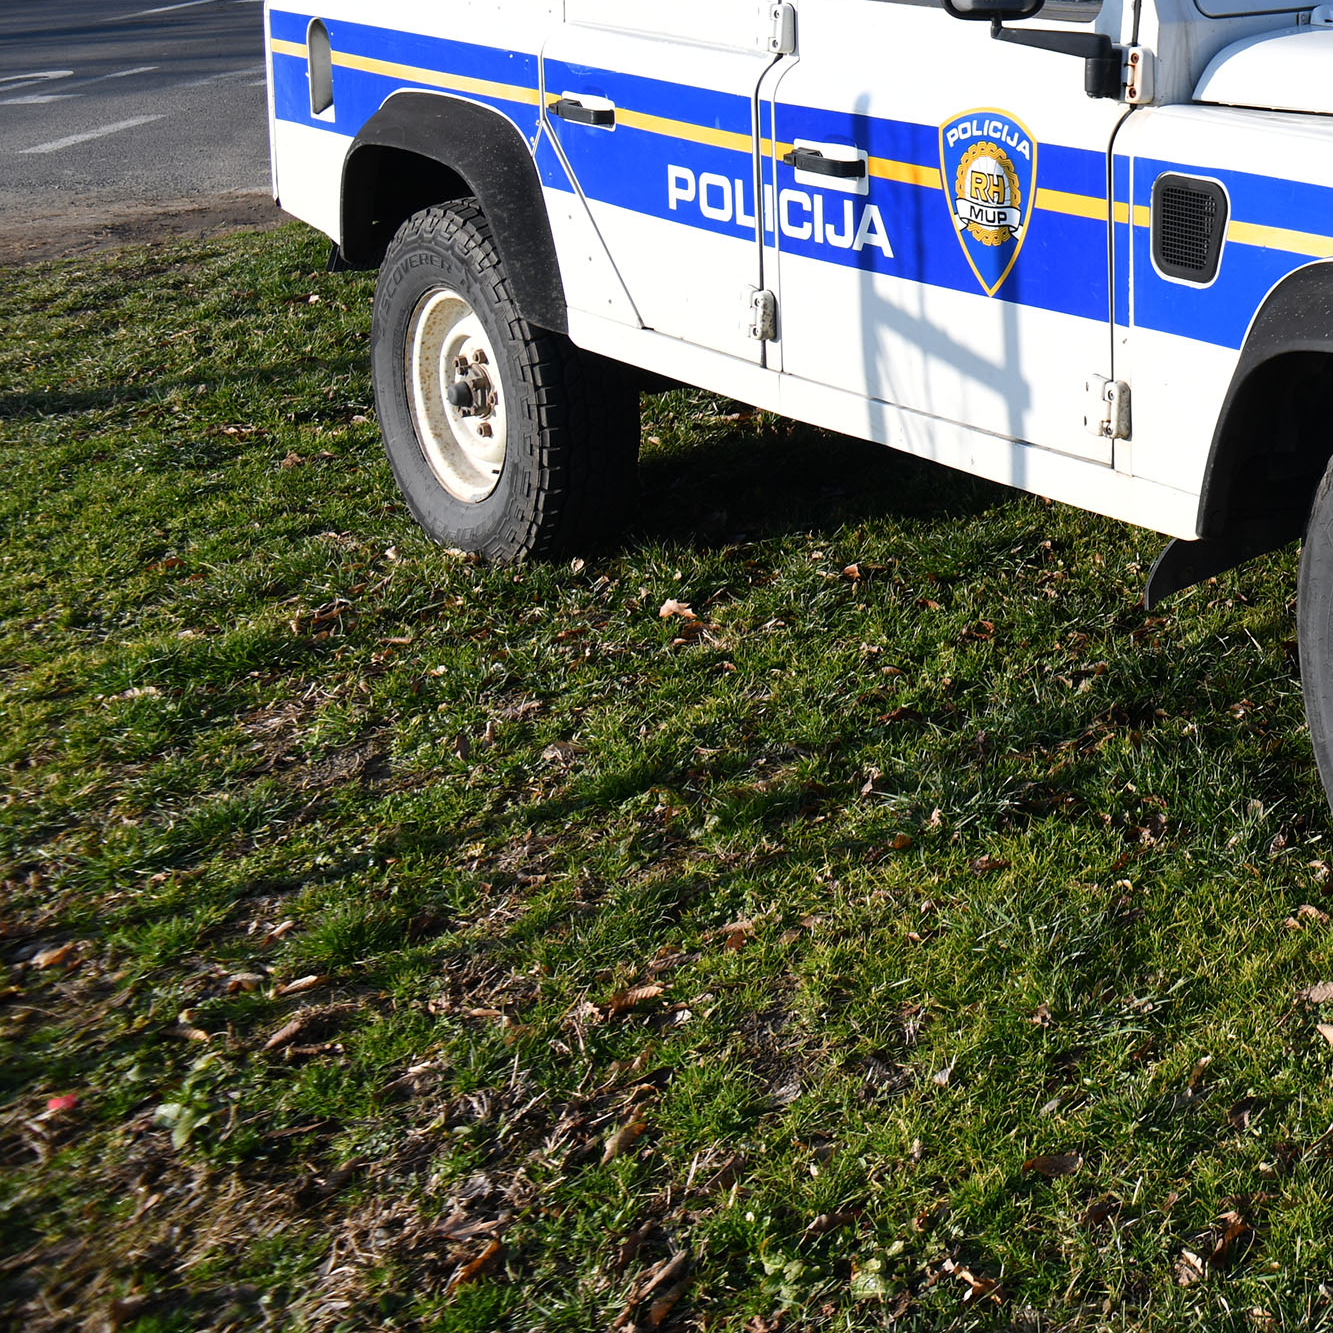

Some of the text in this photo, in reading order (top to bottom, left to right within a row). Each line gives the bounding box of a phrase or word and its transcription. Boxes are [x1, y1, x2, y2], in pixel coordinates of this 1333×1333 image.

[946, 119, 1030, 161] POLICIJA
[970, 170, 1006, 205] RH
[667, 163, 895, 259] POLICIJA
[970, 205, 1008, 225] MUP
